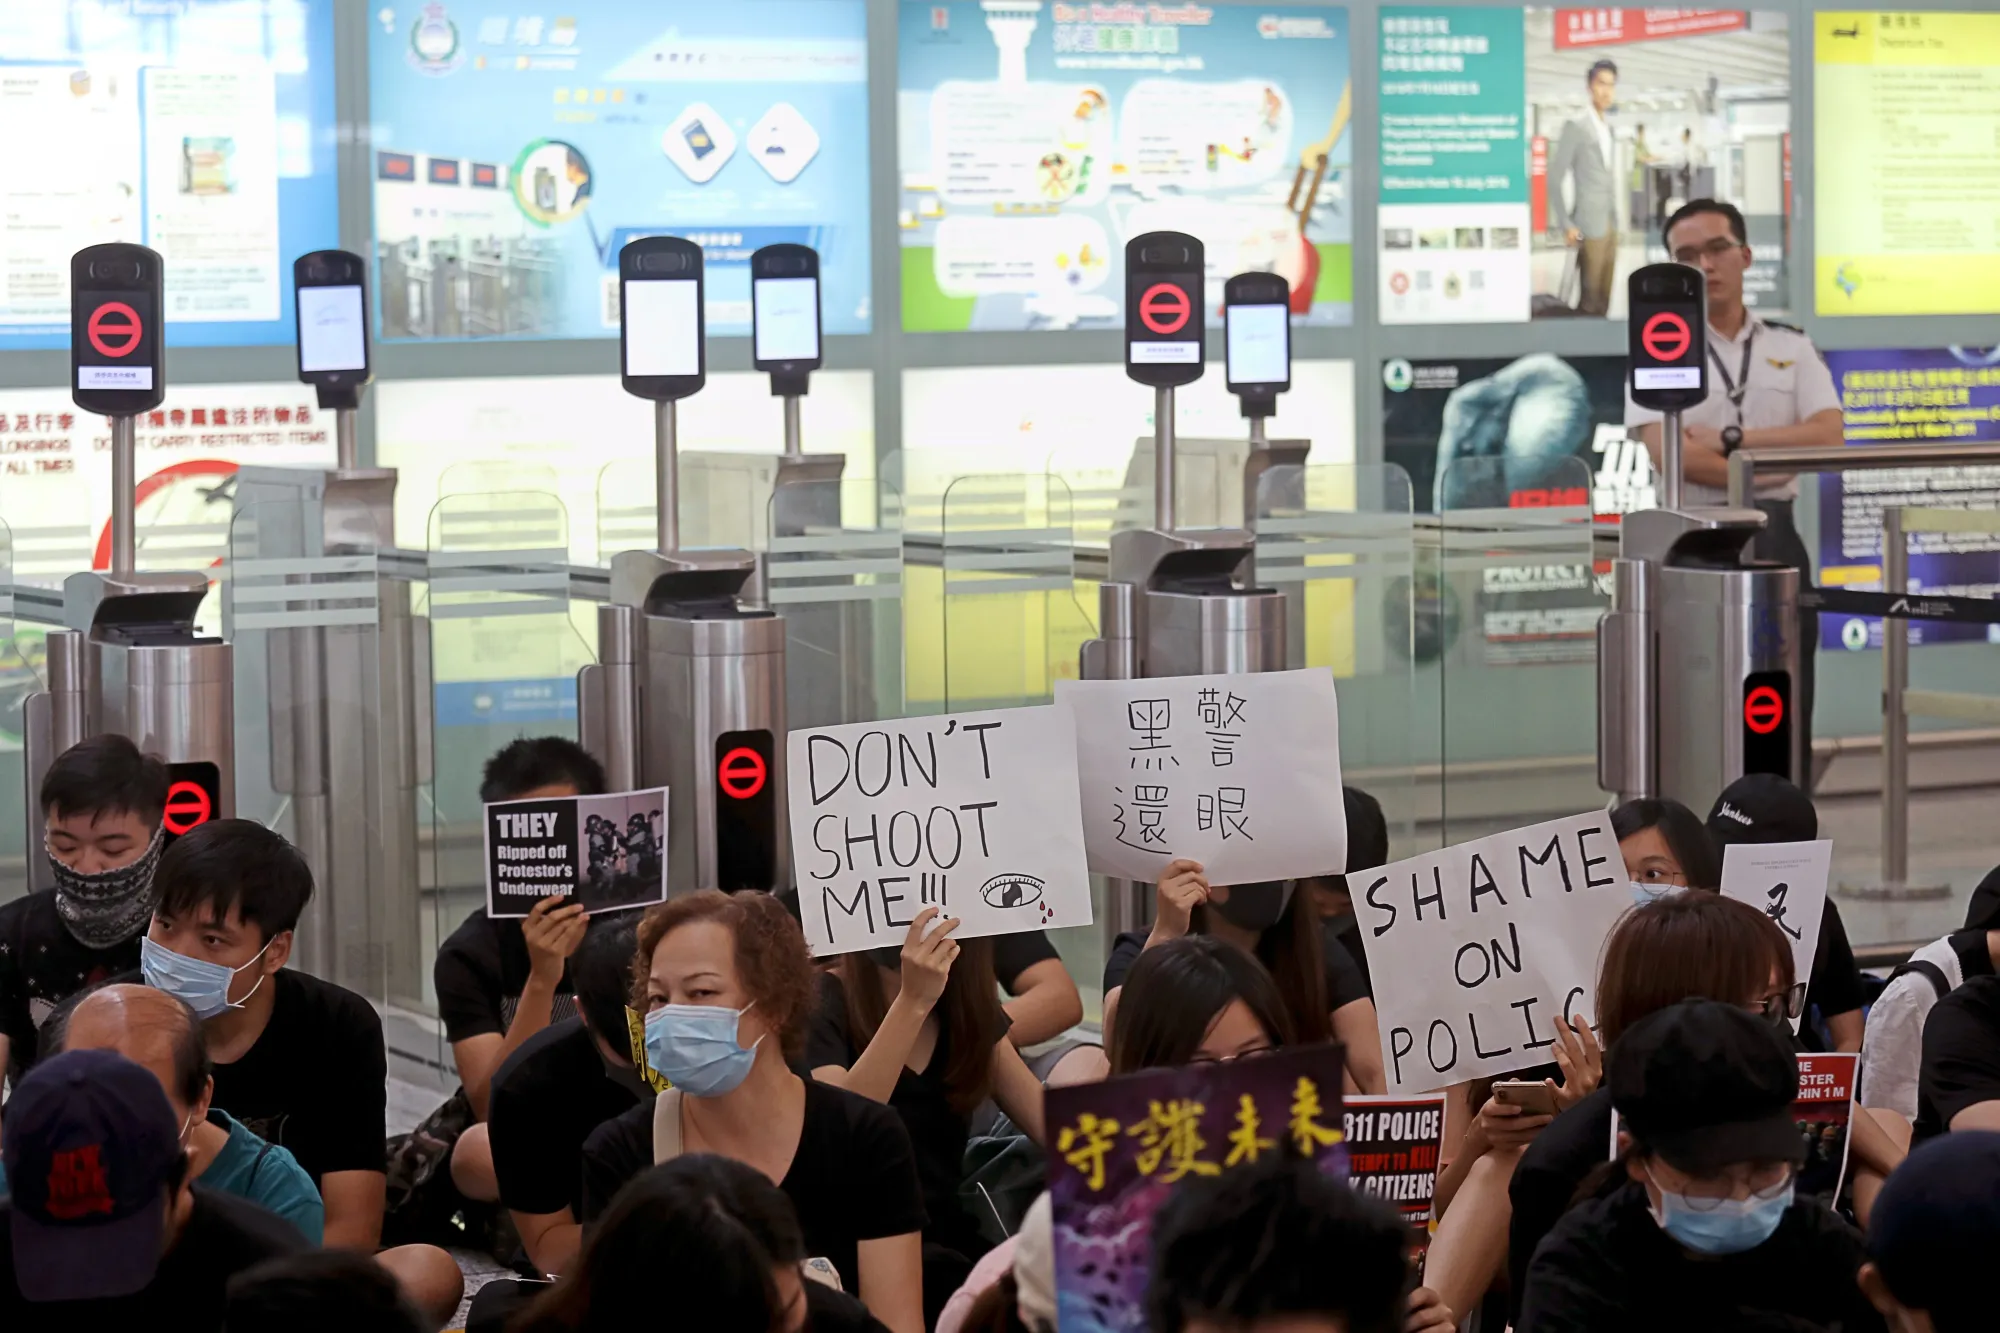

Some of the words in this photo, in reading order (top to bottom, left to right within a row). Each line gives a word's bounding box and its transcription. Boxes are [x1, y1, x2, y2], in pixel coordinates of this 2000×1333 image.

[808, 720, 1002, 805] DON'T
[496, 812, 559, 839] THEY
[1113, 786, 1253, 855] 還眼
[497, 845, 545, 860] Ripped
[548, 845, 567, 859] off
[810, 801, 998, 879] SHOOT
[498, 864, 573, 878] Protestor's
[1366, 827, 1615, 938] SHAME
[499, 882, 574, 896] Underwear
[1455, 922, 1522, 988] ON
[1824, 1087, 1830, 1098] 1
[1833, 1086, 1845, 1097] M
[1378, 1110, 1439, 1141] POLICE
[1364, 1172, 1435, 1201] CITIZENS
